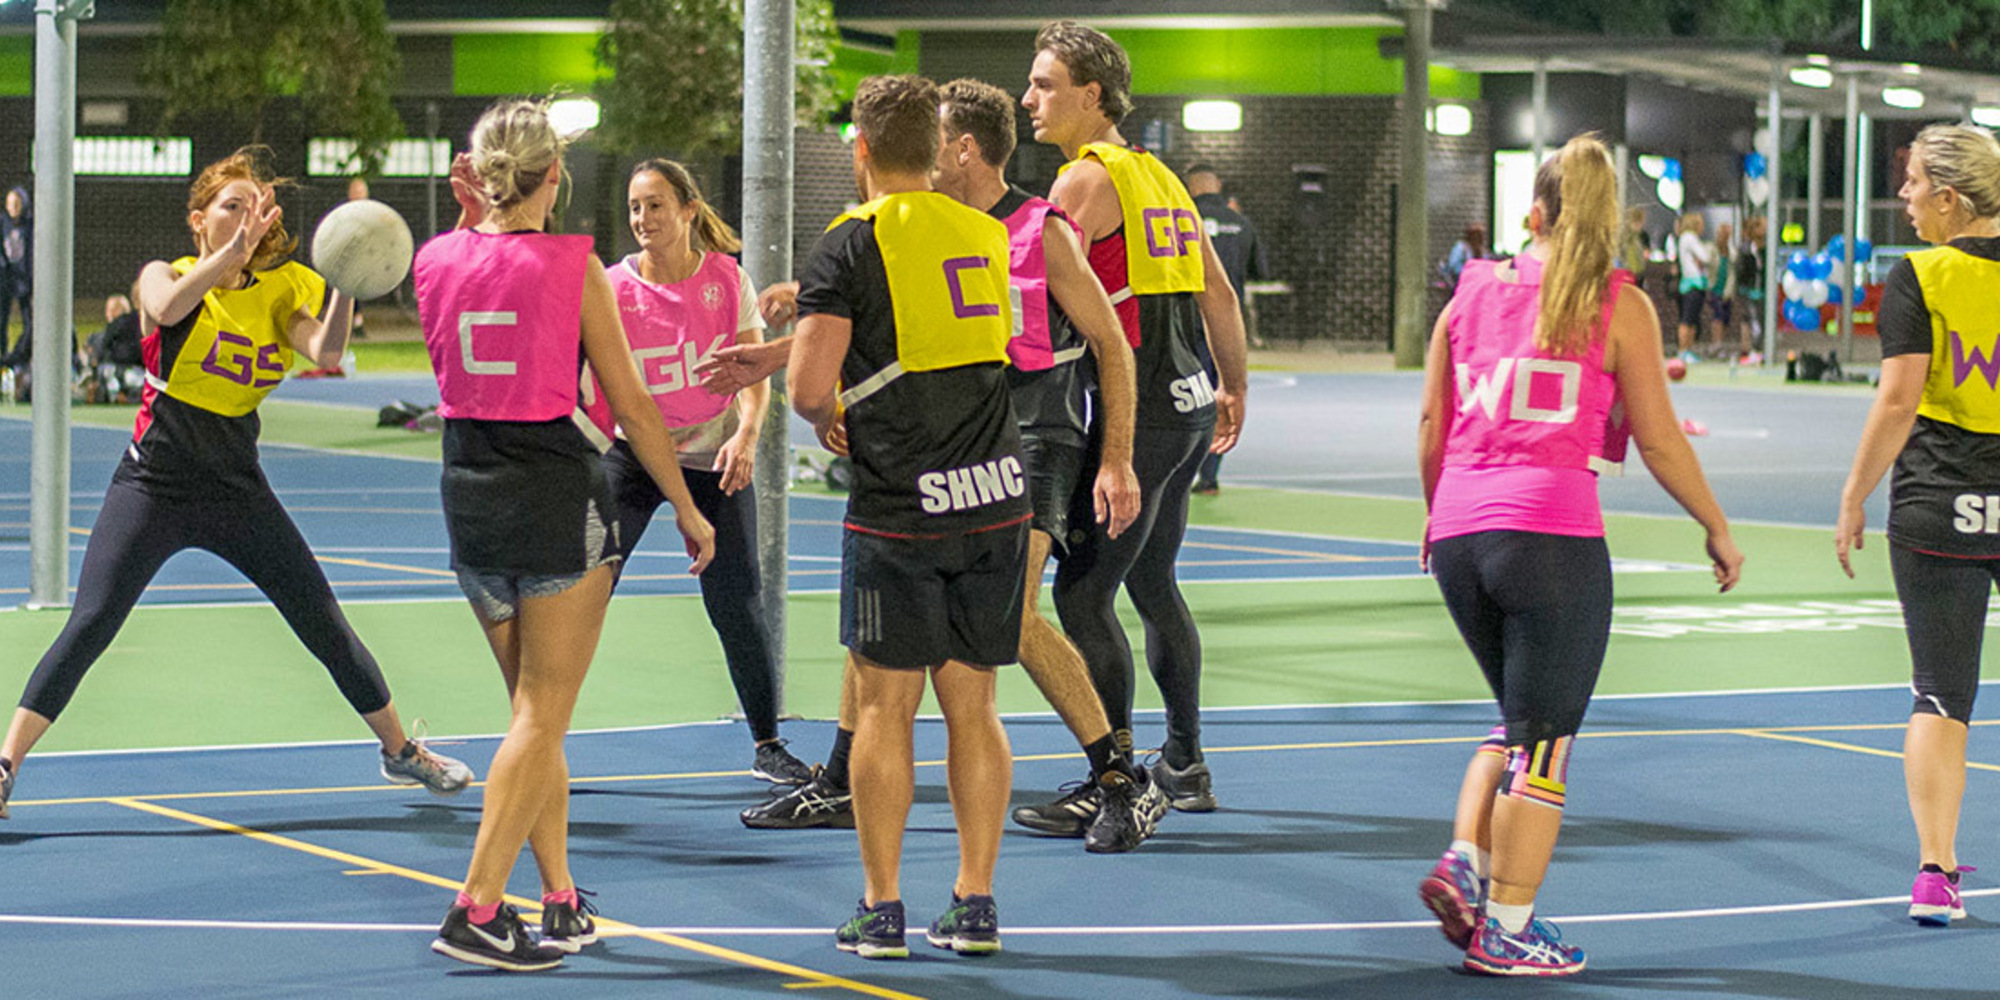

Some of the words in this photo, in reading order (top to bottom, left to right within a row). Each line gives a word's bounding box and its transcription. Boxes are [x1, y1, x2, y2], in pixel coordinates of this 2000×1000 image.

[1143, 207, 1199, 257] GP
[943, 256, 999, 319] C
[201, 330, 284, 388] GS
[458, 311, 517, 375] C
[632, 333, 728, 395] GK
[918, 455, 1025, 513] SHNC
